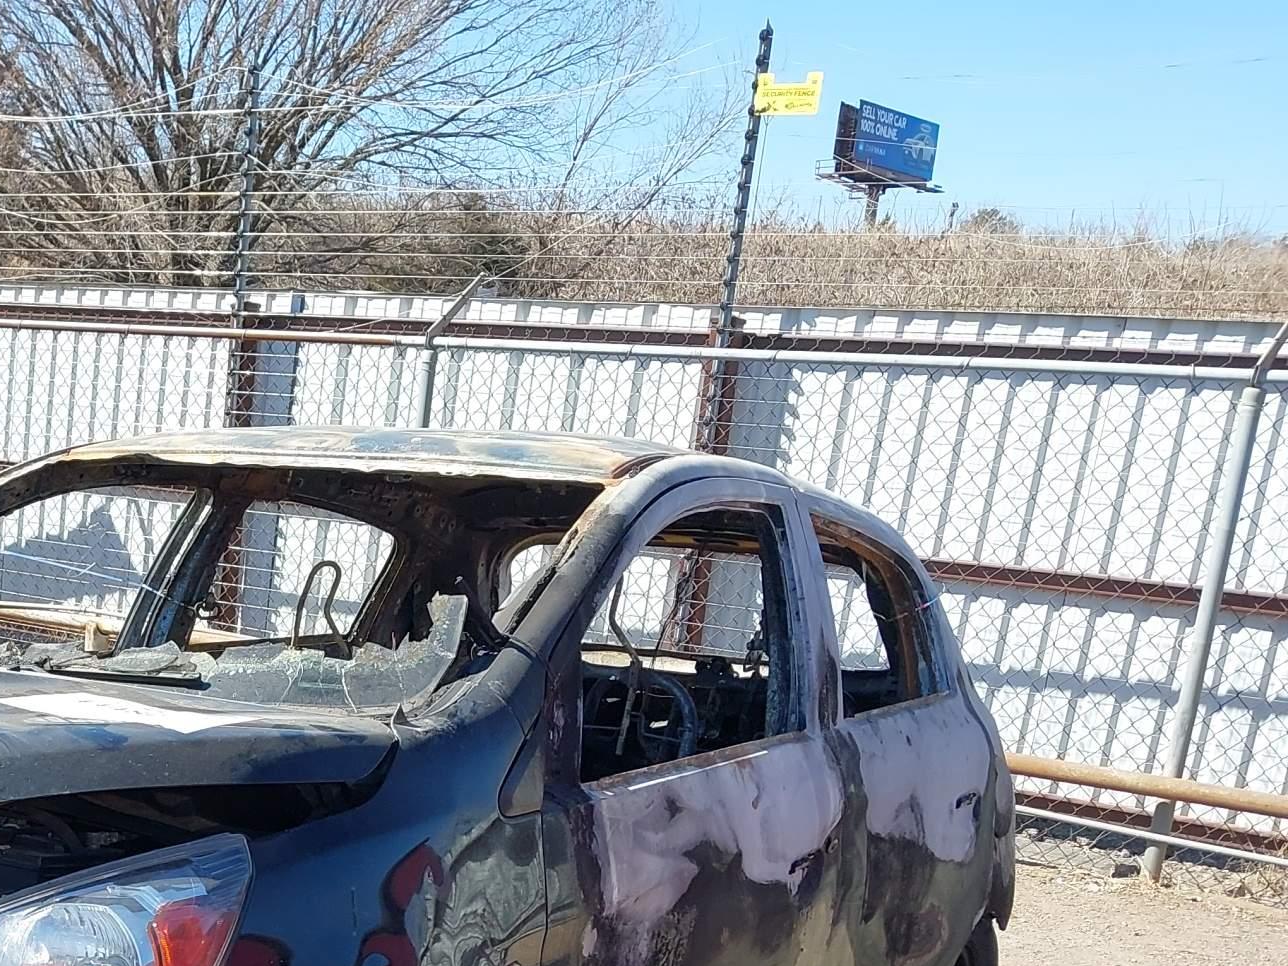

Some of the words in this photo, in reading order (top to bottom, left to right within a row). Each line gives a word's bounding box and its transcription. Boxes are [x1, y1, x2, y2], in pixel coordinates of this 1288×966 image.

[862, 105, 876, 120] SELL
[877, 109, 894, 125] YOUR
[894, 115, 908, 129] CAR
[860, 118, 875, 134] 100%
[875, 124, 899, 141] ONLINE
